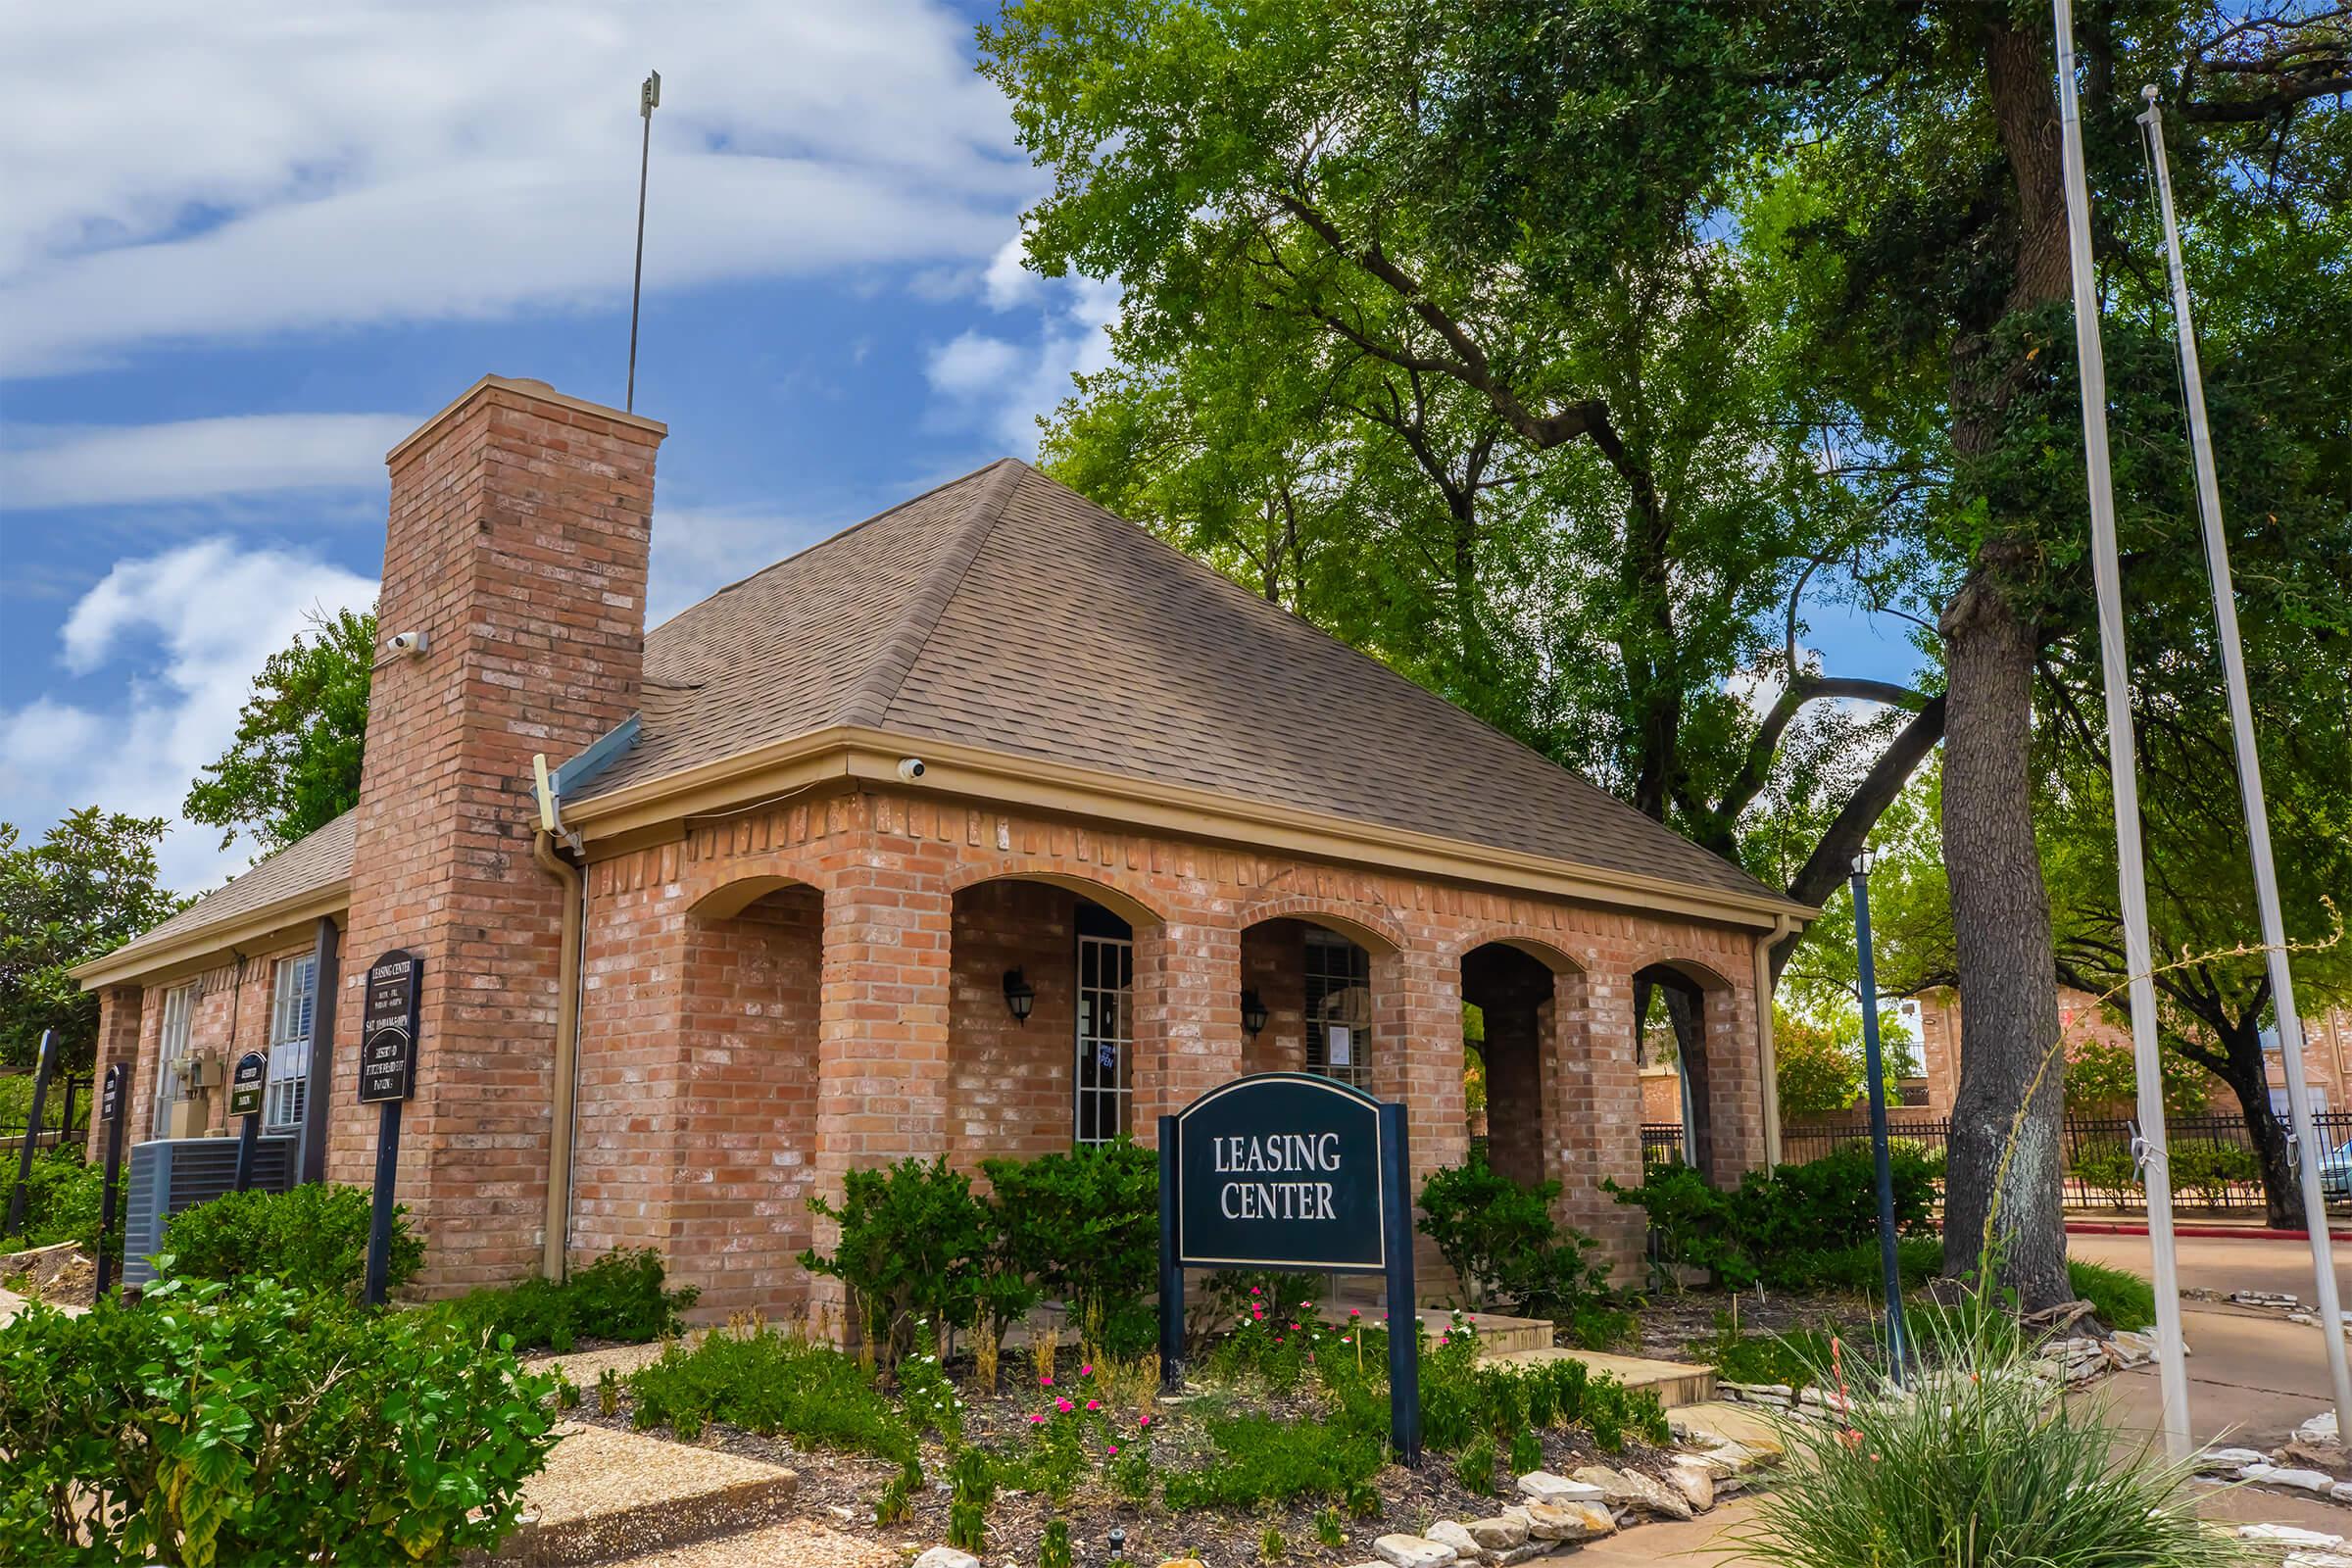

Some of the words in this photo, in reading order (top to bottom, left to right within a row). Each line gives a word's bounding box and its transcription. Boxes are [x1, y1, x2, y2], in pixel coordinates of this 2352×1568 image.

[372, 964, 393, 980] LEASING
[392, 960, 411, 976] CENTER
[1213, 1133, 1342, 1172] LEASING
[1221, 1182, 1337, 1220] CENTER
